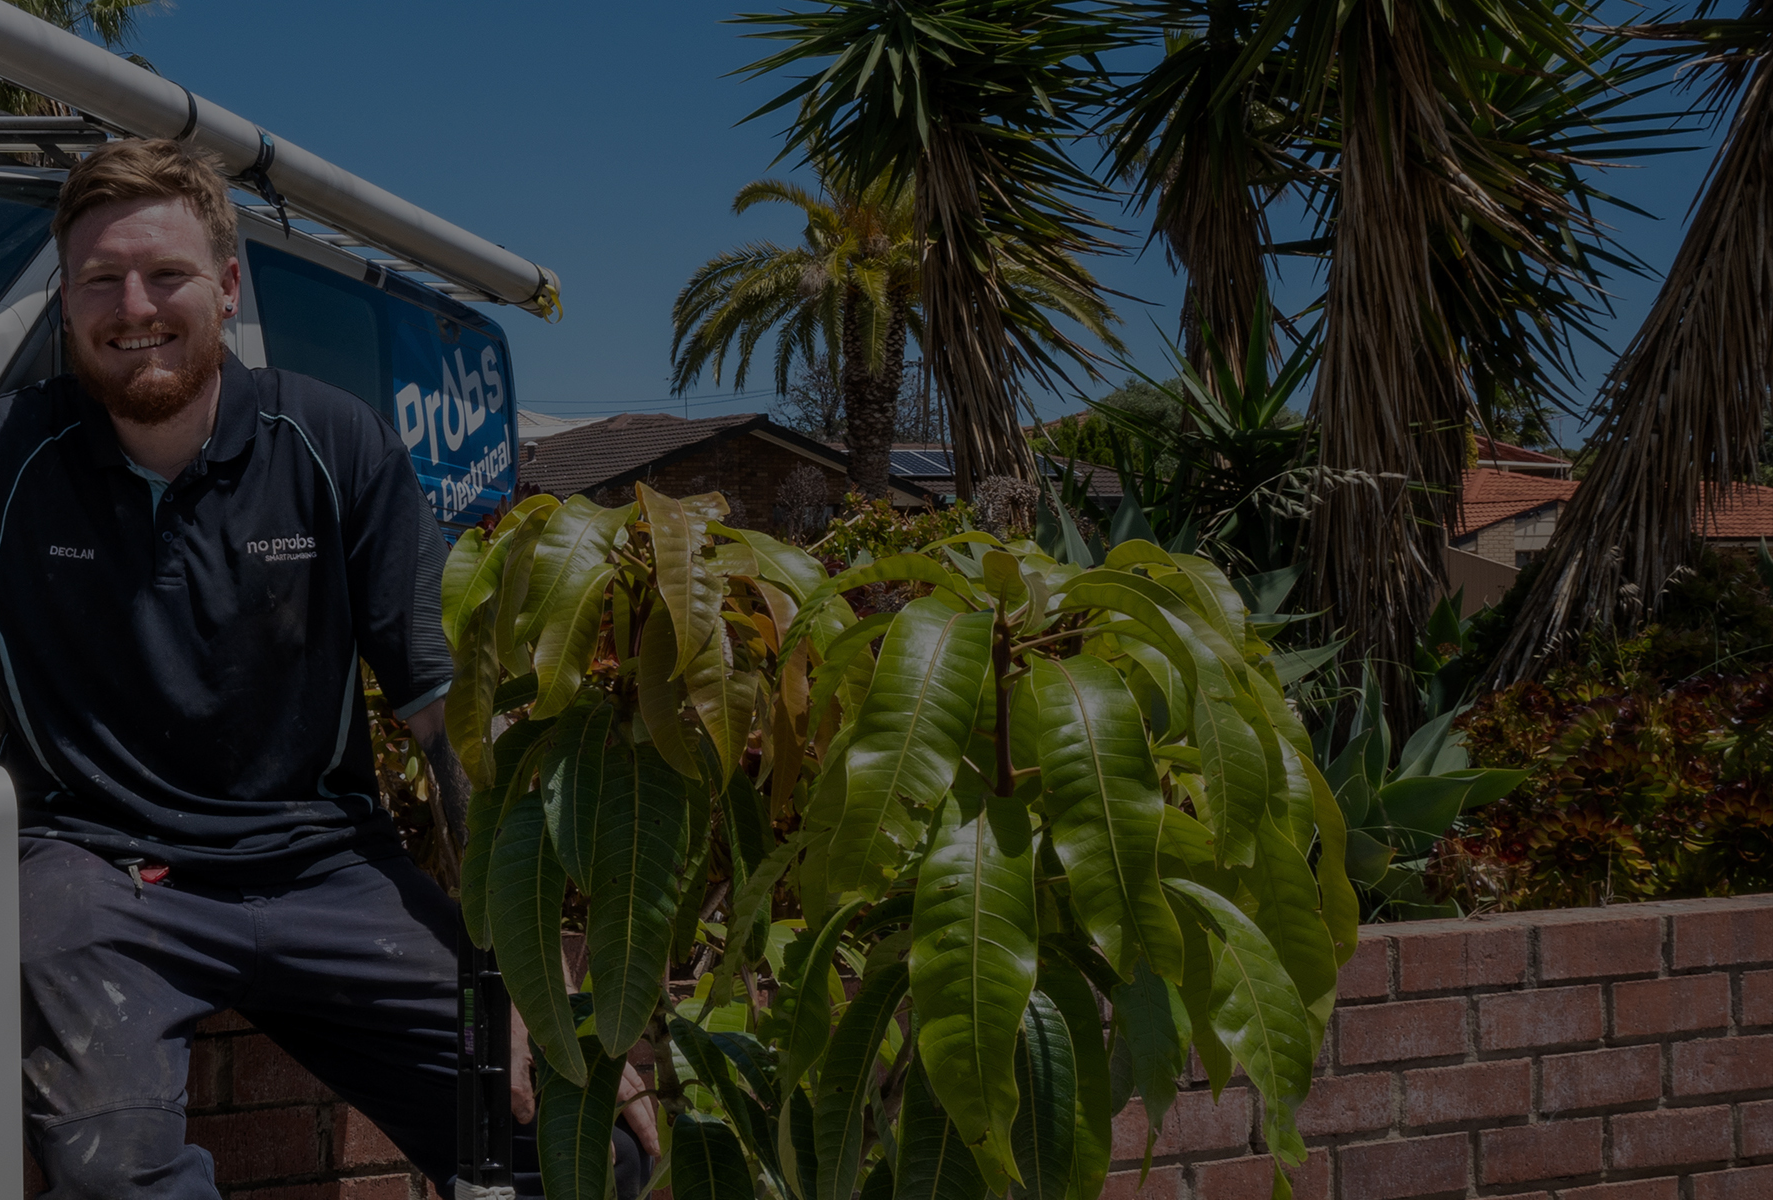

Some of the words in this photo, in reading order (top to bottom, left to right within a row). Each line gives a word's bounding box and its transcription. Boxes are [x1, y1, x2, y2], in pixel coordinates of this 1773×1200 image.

[395, 345, 504, 467] Probs
[441, 422, 513, 522] Electrical
[49, 545, 95, 560] DECLAN
[246, 540, 269, 554] no
[272, 533, 316, 554] probs
[265, 553, 288, 562] SMART
